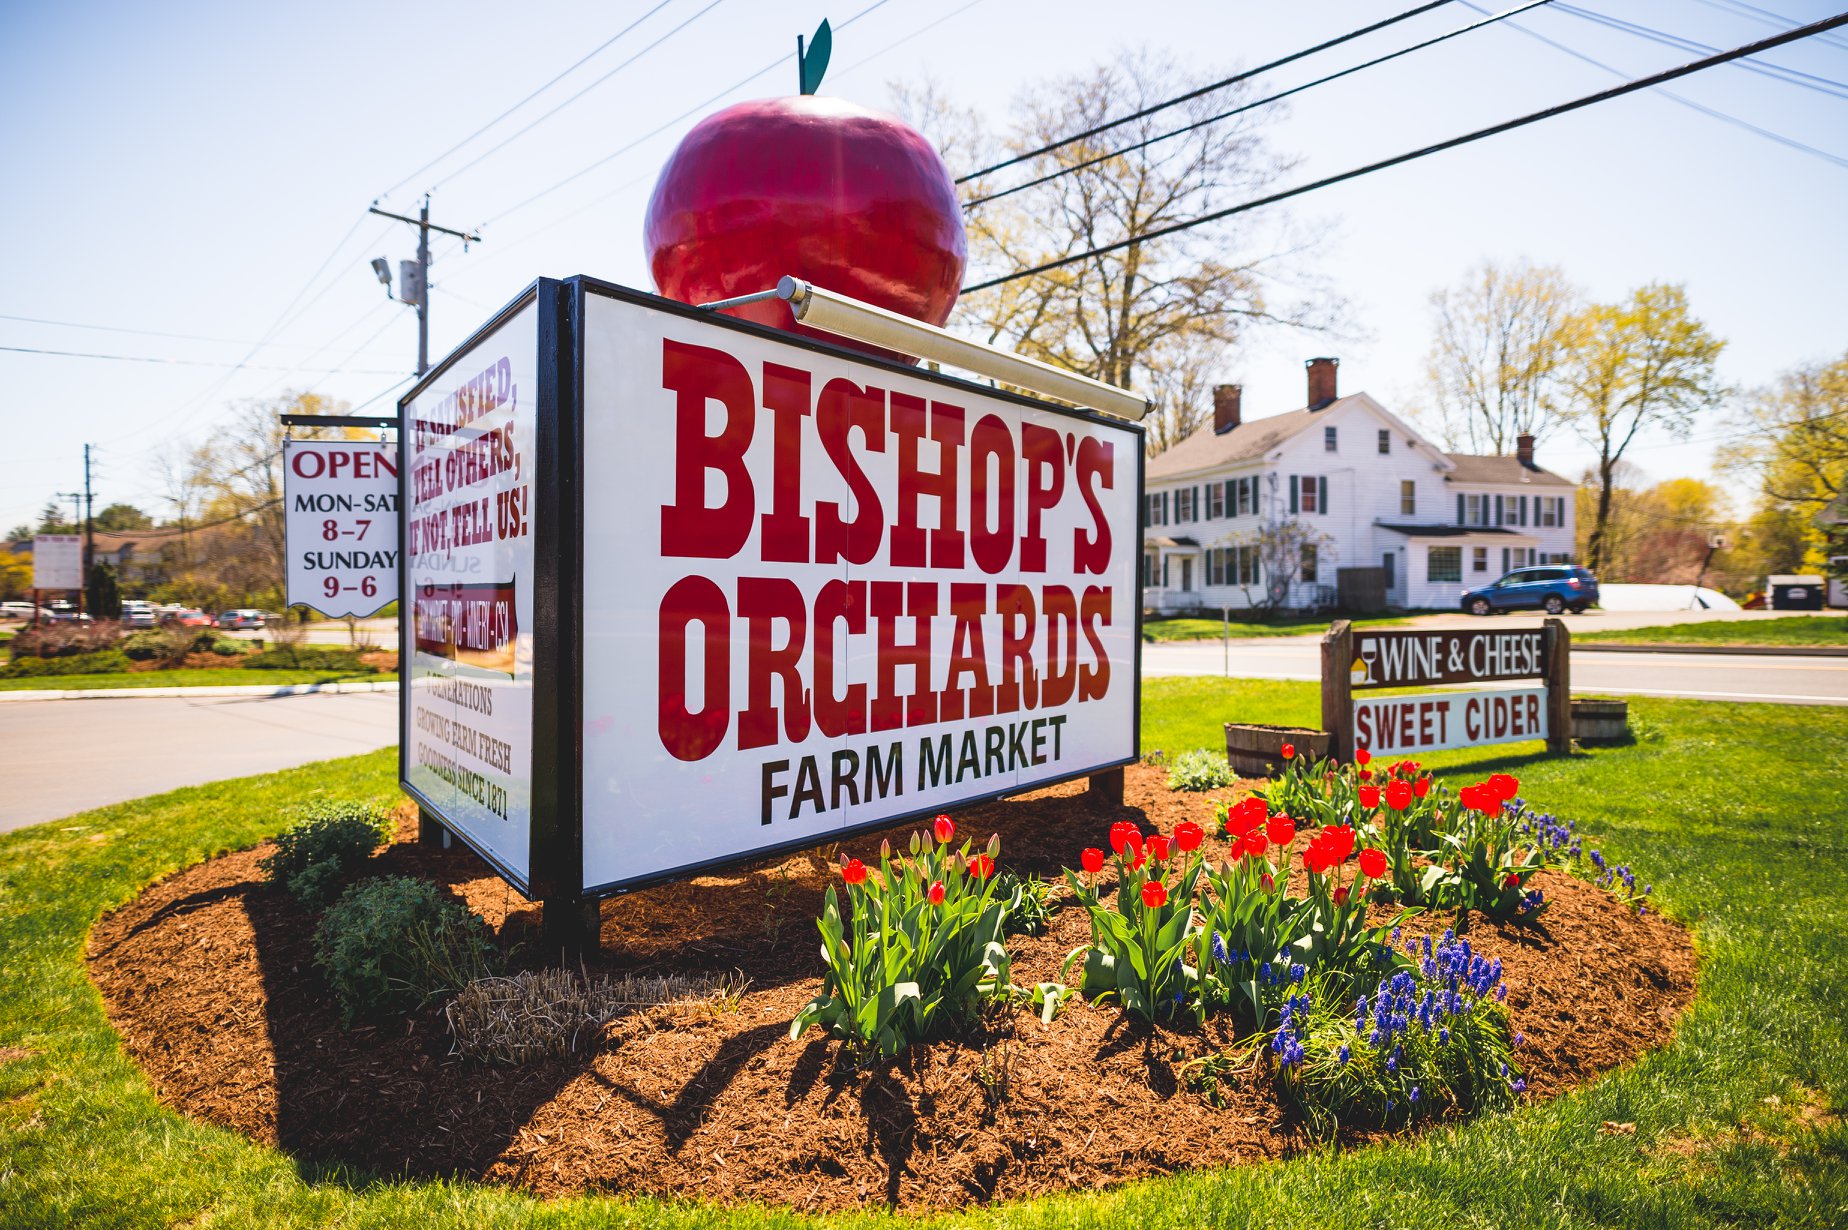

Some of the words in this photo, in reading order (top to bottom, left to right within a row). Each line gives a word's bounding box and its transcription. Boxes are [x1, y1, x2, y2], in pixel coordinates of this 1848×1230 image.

[292, 450, 398, 479] OPEN
[414, 458, 442, 505] TELL
[446, 420, 520, 492] OTHERS,
[661, 337, 1114, 575] BISHOP'S
[410, 520, 419, 556] IF
[422, 510, 450, 560] NOT,
[452, 497, 492, 547] TELL
[497, 485, 527, 540] US!
[303, 550, 398, 570] SUNDAY
[495, 601, 509, 654] CSA
[1379, 636, 1443, 681] WINE
[1448, 637, 1465, 672] &
[1469, 633, 1542, 678] CHEESE
[658, 574, 1112, 761] ORCHARDS
[417, 706, 450, 743] GROWING
[452, 720, 476, 757] FARM
[479, 732, 511, 775] FRESH
[1356, 701, 1450, 751] SWEET
[1465, 694, 1540, 742] CIDER
[418, 742, 456, 786] GOODNESS
[458, 764, 484, 805] SINCE
[487, 781, 507, 821] 1871
[761, 741, 903, 826] FARM
[918, 715, 1067, 791] MARKET
